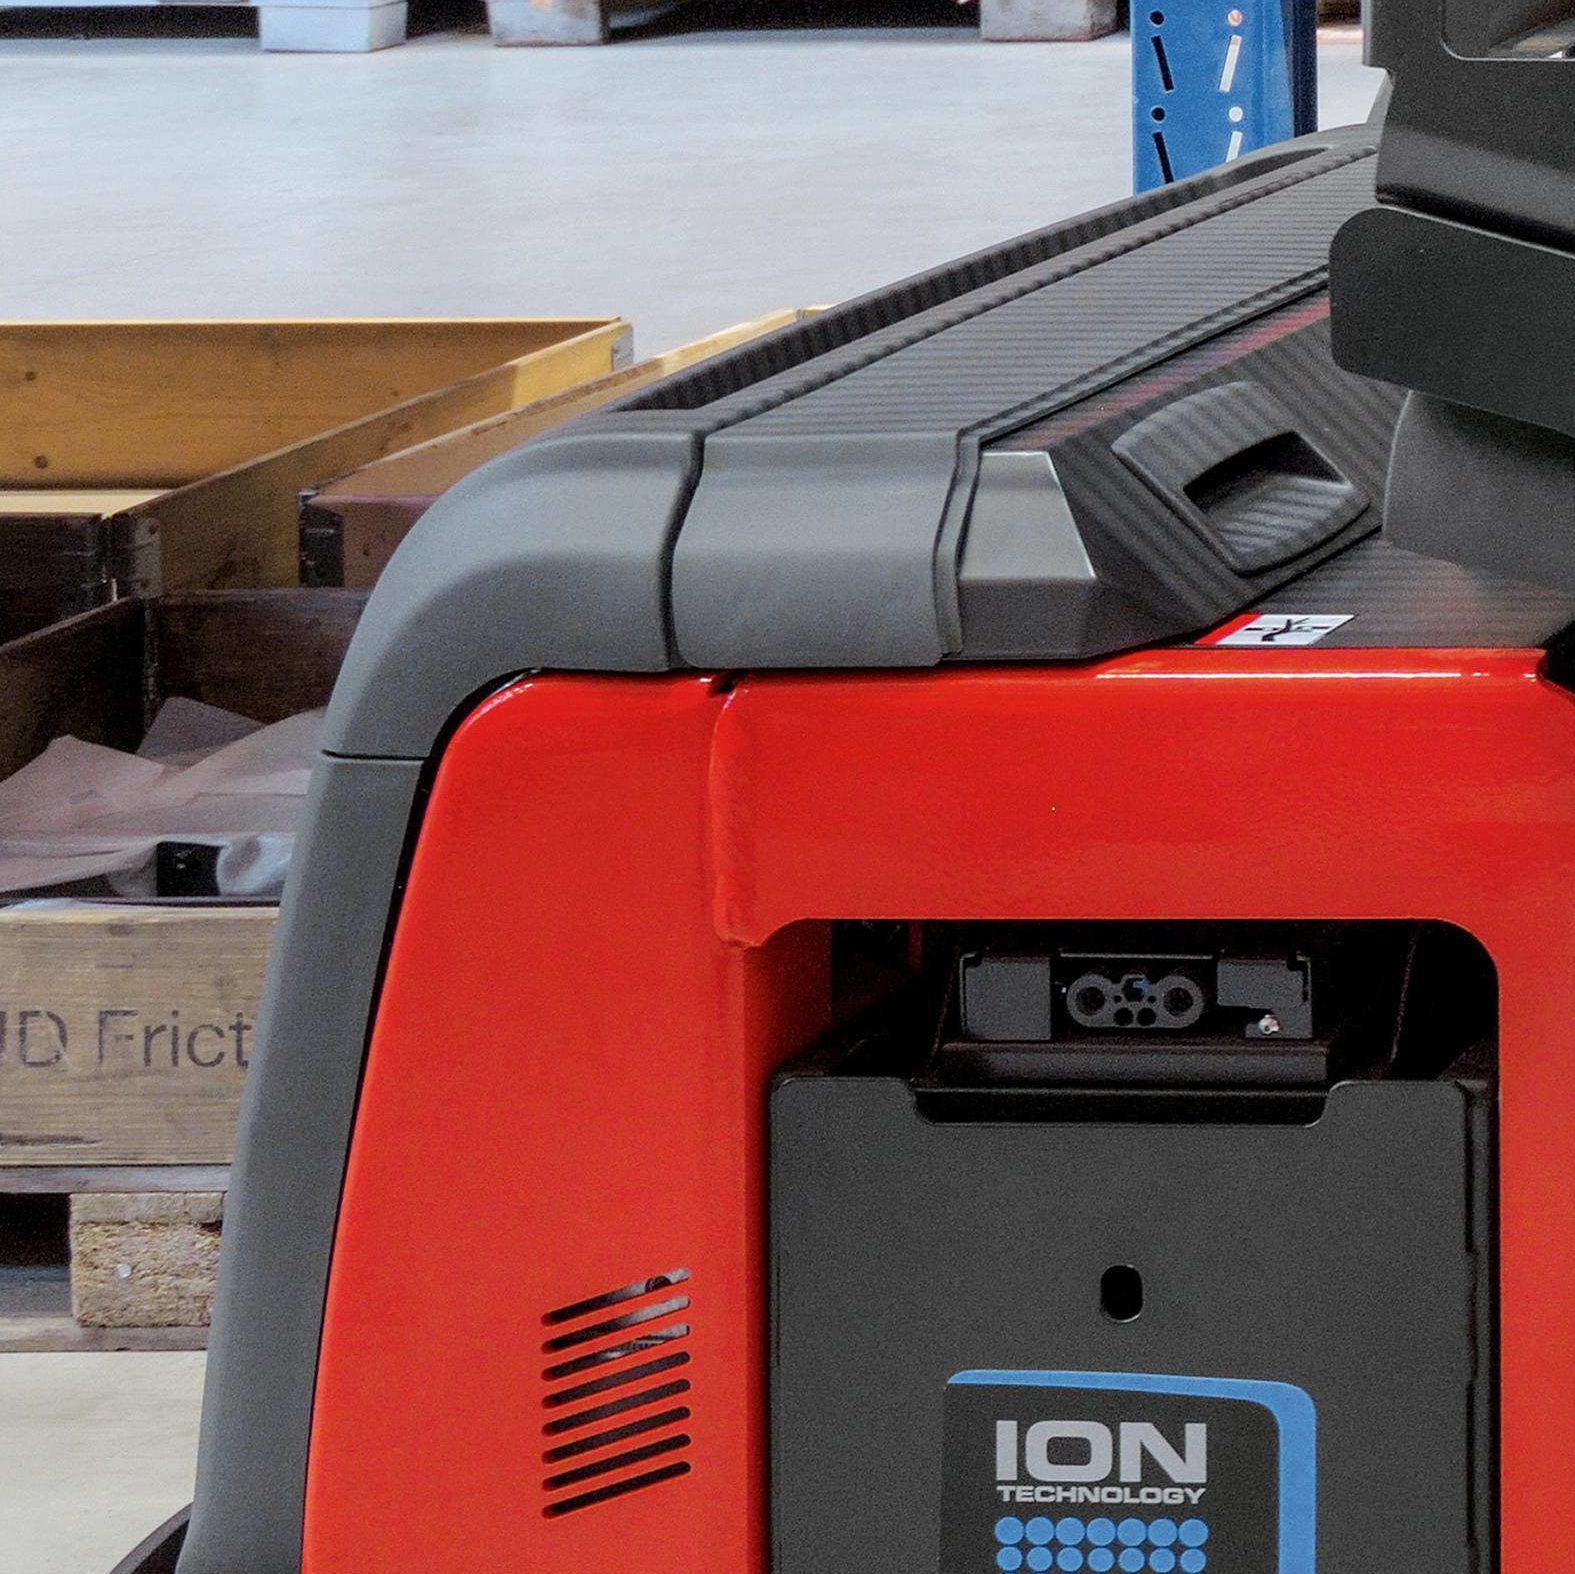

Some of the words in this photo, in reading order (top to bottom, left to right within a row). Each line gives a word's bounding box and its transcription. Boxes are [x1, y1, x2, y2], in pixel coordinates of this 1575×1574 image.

[97, 1009, 252, 1068] Frict
[996, 1419, 1207, 1484] ION
[996, 1485, 1206, 1506] TECHNOLOGY
